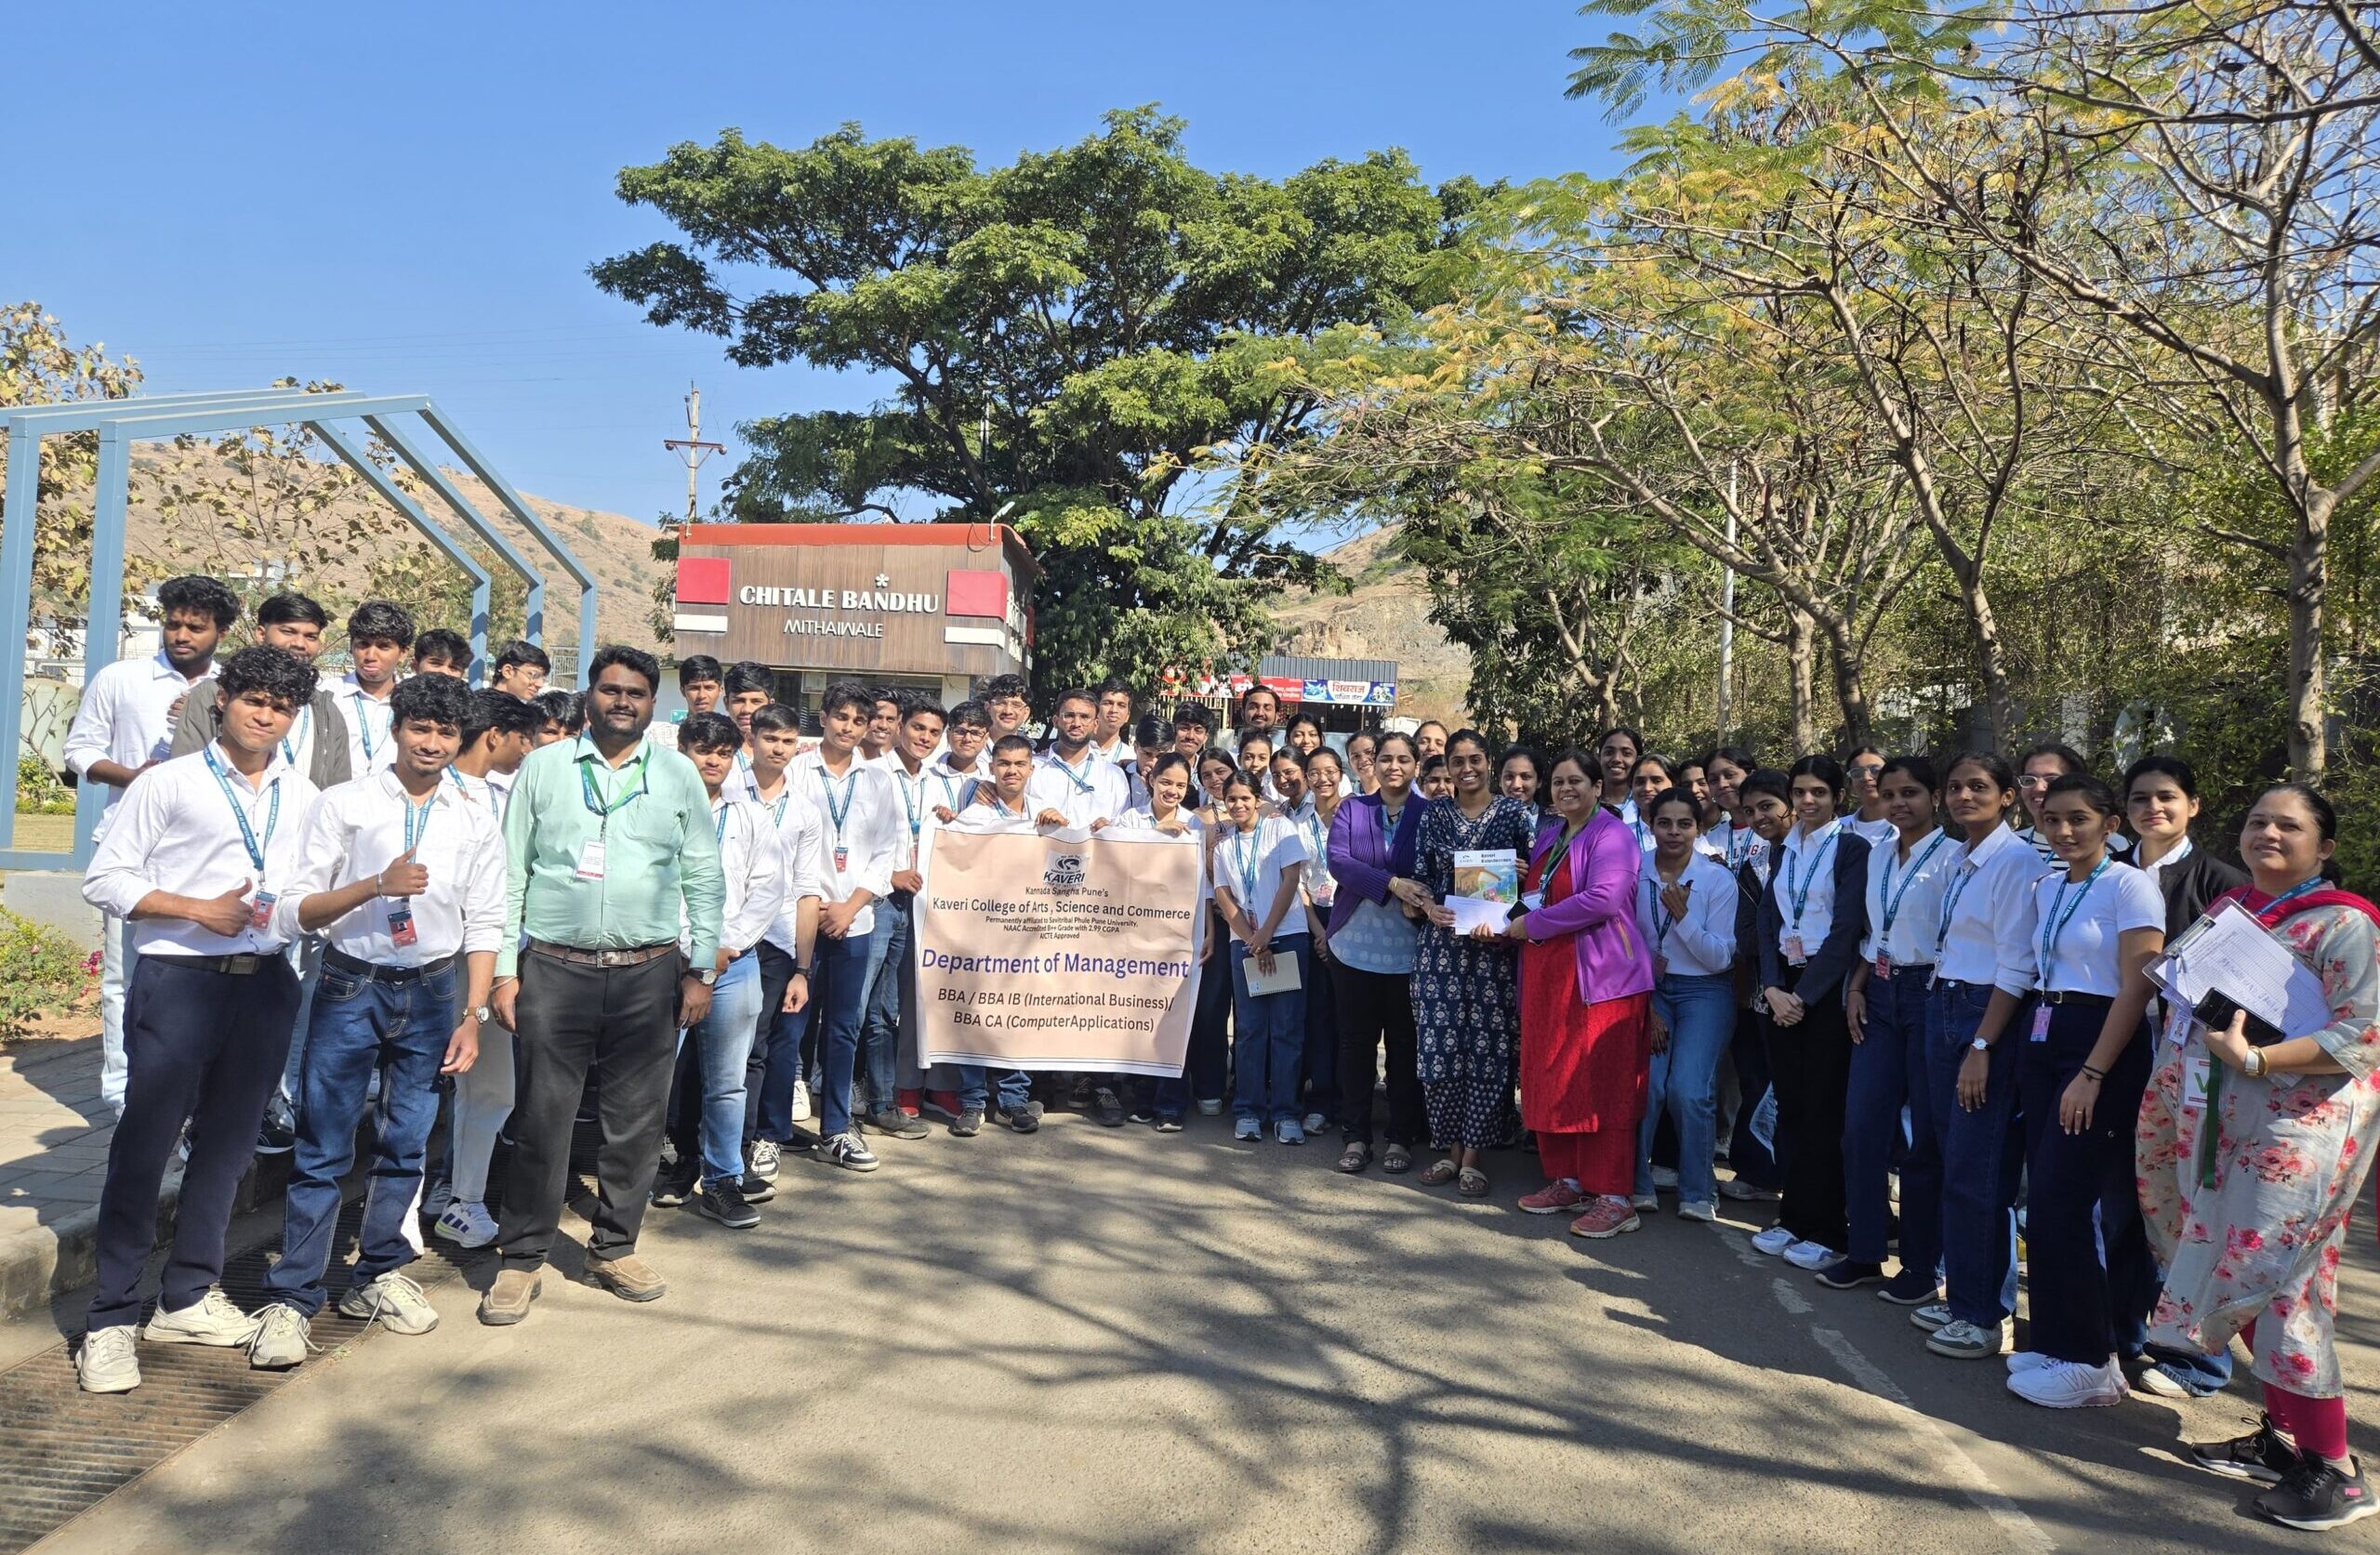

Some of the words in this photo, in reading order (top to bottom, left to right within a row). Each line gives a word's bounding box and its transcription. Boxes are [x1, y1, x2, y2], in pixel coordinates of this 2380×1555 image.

[739, 586, 835, 609] CHITALE
[841, 590, 939, 613] BANDHU
[784, 619, 883, 638] MITHAIWALE
[1043, 871, 1086, 884] KAVERI
[1025, 887, 1050, 895] Kannada
[1051, 887, 1079, 897] Sangha
[1081, 887, 1108, 897] Pune's
[932, 897, 968, 910] Kaveri
[972, 899, 1015, 916] College
[1018, 901, 1030, 913] of
[1032, 902, 1049, 913] Arts
[1055, 901, 1100, 914] Science
[1103, 904, 1124, 916] and
[1127, 905, 1191, 919] Commerce
[985, 916, 1022, 924] Permanently
[922, 949, 1040, 974] Department
[1044, 953, 1061, 972] of
[1064, 954, 1189, 979] Management
[938, 988, 966, 1003] BBA
[978, 993, 1005, 1005] BBA
[1008, 993, 1021, 1005] IB
[1024, 992, 1104, 1007] (International
[954, 1011, 982, 1026] BBA
[985, 1015, 1002, 1028] CA
[1006, 1015, 1154, 1033] (ComputerApplications)
